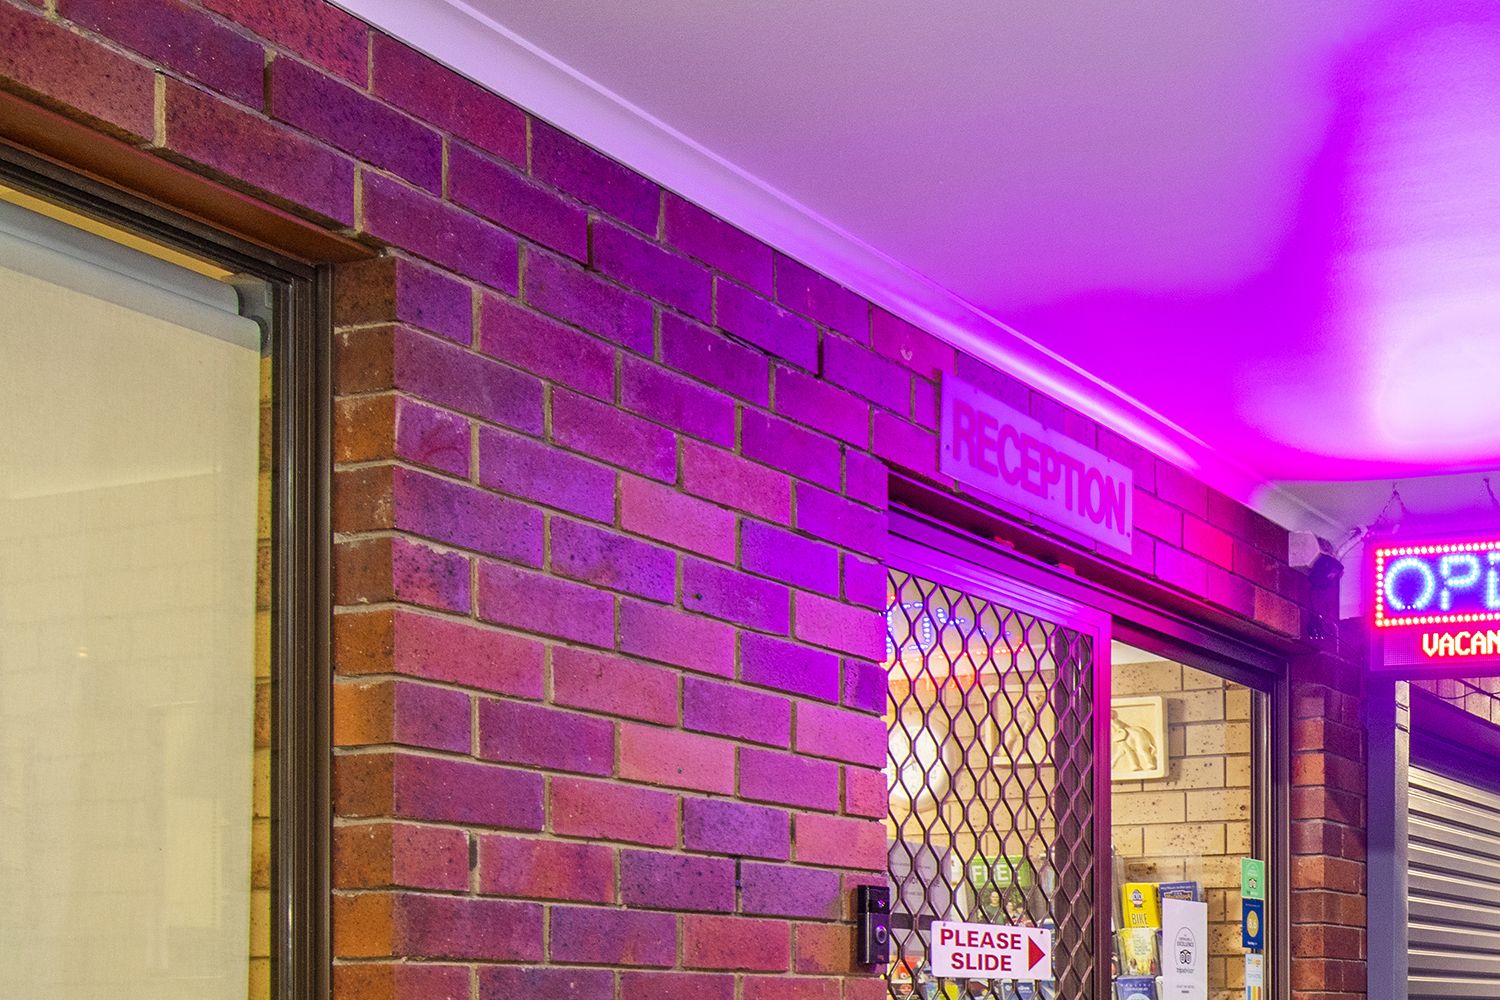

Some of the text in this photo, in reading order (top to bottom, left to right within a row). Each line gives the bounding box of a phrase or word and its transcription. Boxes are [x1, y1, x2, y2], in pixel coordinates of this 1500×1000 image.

[952, 399, 1126, 535] RECEPTION
[940, 928, 1022, 950] PLEASE
[951, 952, 1012, 972] SLIDE
